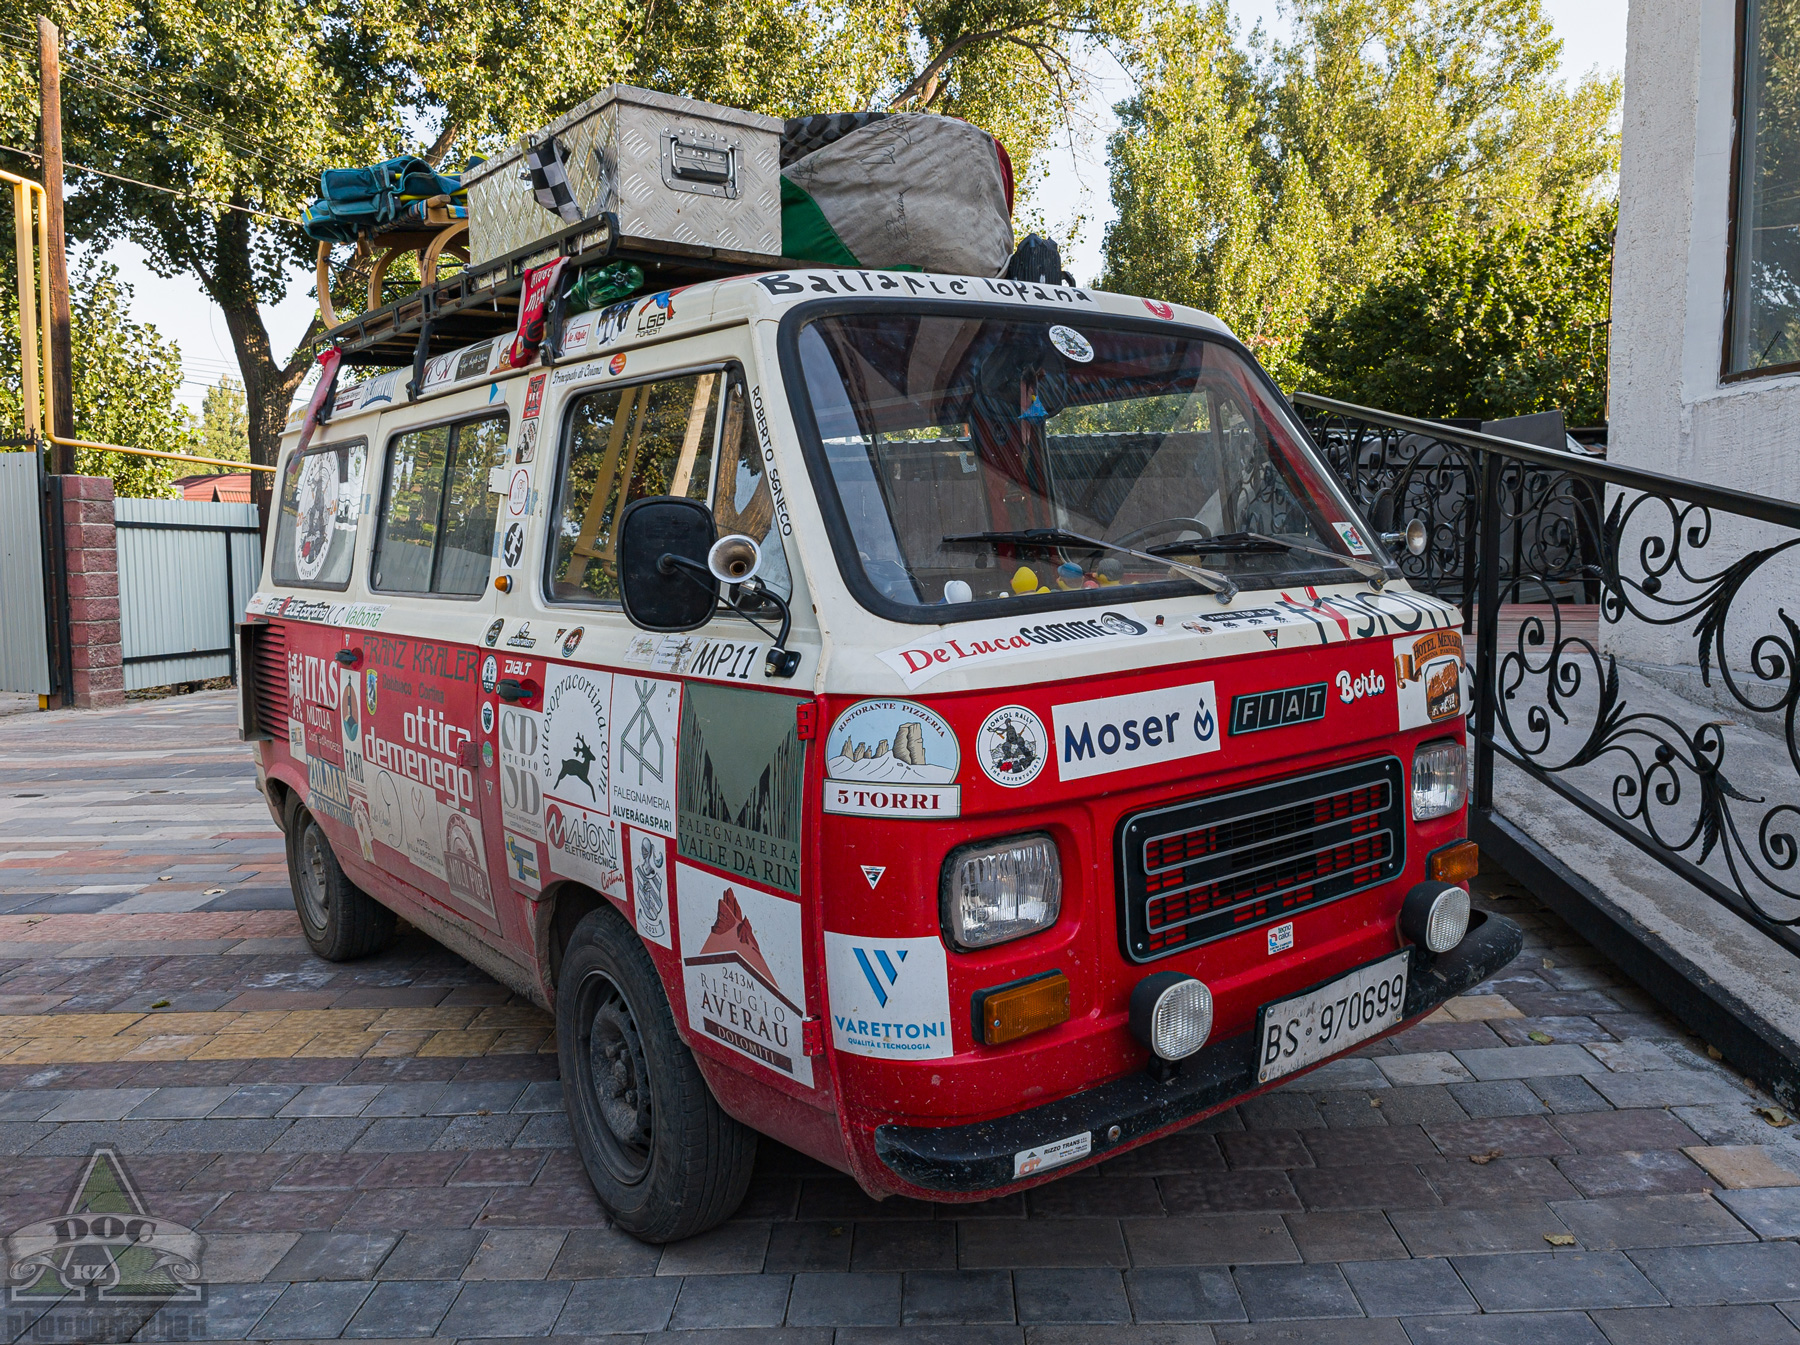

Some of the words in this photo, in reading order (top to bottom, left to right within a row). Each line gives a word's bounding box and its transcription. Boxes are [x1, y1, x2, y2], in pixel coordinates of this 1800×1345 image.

[635, 327, 663, 339] FOREST
[637, 312, 666, 332] LGB
[751, 385, 775, 463] ROBERTO
[769, 467, 793, 537] SGNECO
[344, 605, 382, 628] Valbona
[362, 635, 405, 670] FRANZ
[413, 642, 480, 686] KRALER
[304, 655, 339, 710] ITAS
[382, 673, 412, 697] Dobbiaco
[418, 680, 445, 704] Cortina
[1335, 668, 1386, 704] Berto
[306, 704, 333, 733] MUTUA
[838, 703, 896, 733] RISTORANTE
[902, 705, 945, 738] PIZZERIA
[986, 712, 1013, 731] MONGOL
[1015, 711, 1034, 724] RALLY
[1242, 689, 1323, 726] FIAT
[1063, 711, 1180, 763] Moser
[345, 748, 364, 784] FARO
[365, 726, 474, 811] demenego
[502, 751, 539, 771] STUDIO
[307, 754, 351, 808] ZOLDAN
[613, 785, 671, 812] FALEGNAMERIA
[837, 789, 849, 805] 5
[854, 791, 941, 810] TORRI
[679, 813, 799, 865] FALEGNAMERIA
[564, 843, 618, 871] ELETTROTECNICA
[679, 832, 728, 867] VALLE
[733, 850, 757, 877] DA
[763, 859, 798, 890] RIN
[601, 867, 625, 891] Cortina
[722, 966, 756, 992] 2413M
[701, 972, 785, 1023] RIFUGIO
[701, 992, 788, 1048] AVERAU
[834, 1015, 946, 1039] VARETTONI
[1264, 1018, 1300, 1066] BS
[1318, 974, 1404, 1044] 970699
[717, 1026, 776, 1065] DOLOMITI
[847, 1036, 876, 1048] QUALITÀ
[882, 1042, 931, 1051] TECNOLOGIA
[1043, 1145, 1061, 1155] RIZZO
[1062, 1138, 1081, 1149] TRANS
